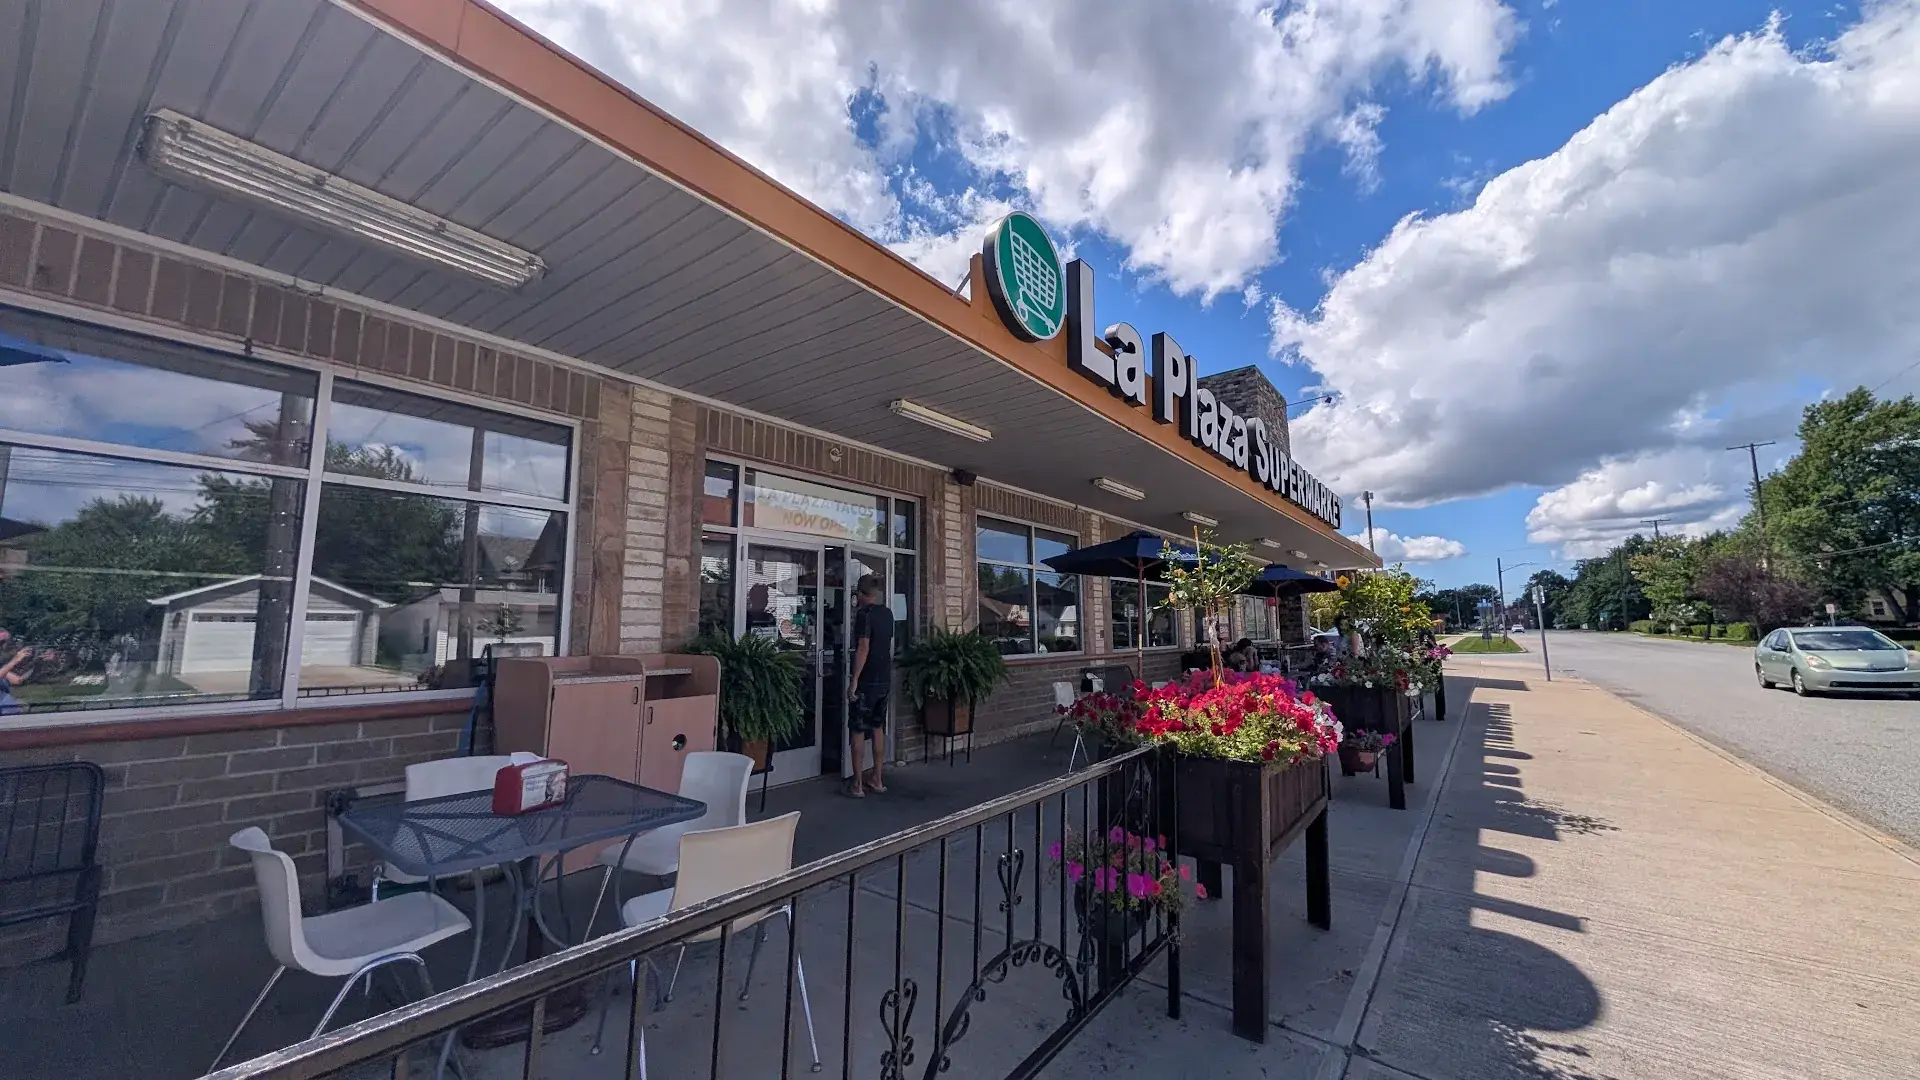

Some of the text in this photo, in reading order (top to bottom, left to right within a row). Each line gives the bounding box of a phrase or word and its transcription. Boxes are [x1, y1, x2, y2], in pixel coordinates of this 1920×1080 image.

[1067, 258, 1145, 406] La
[1152, 332, 1248, 471] Plaza
[781, 490, 830, 509] PLAZA
[834, 500, 873, 516] TACOS
[783, 510, 817, 528] NOW
